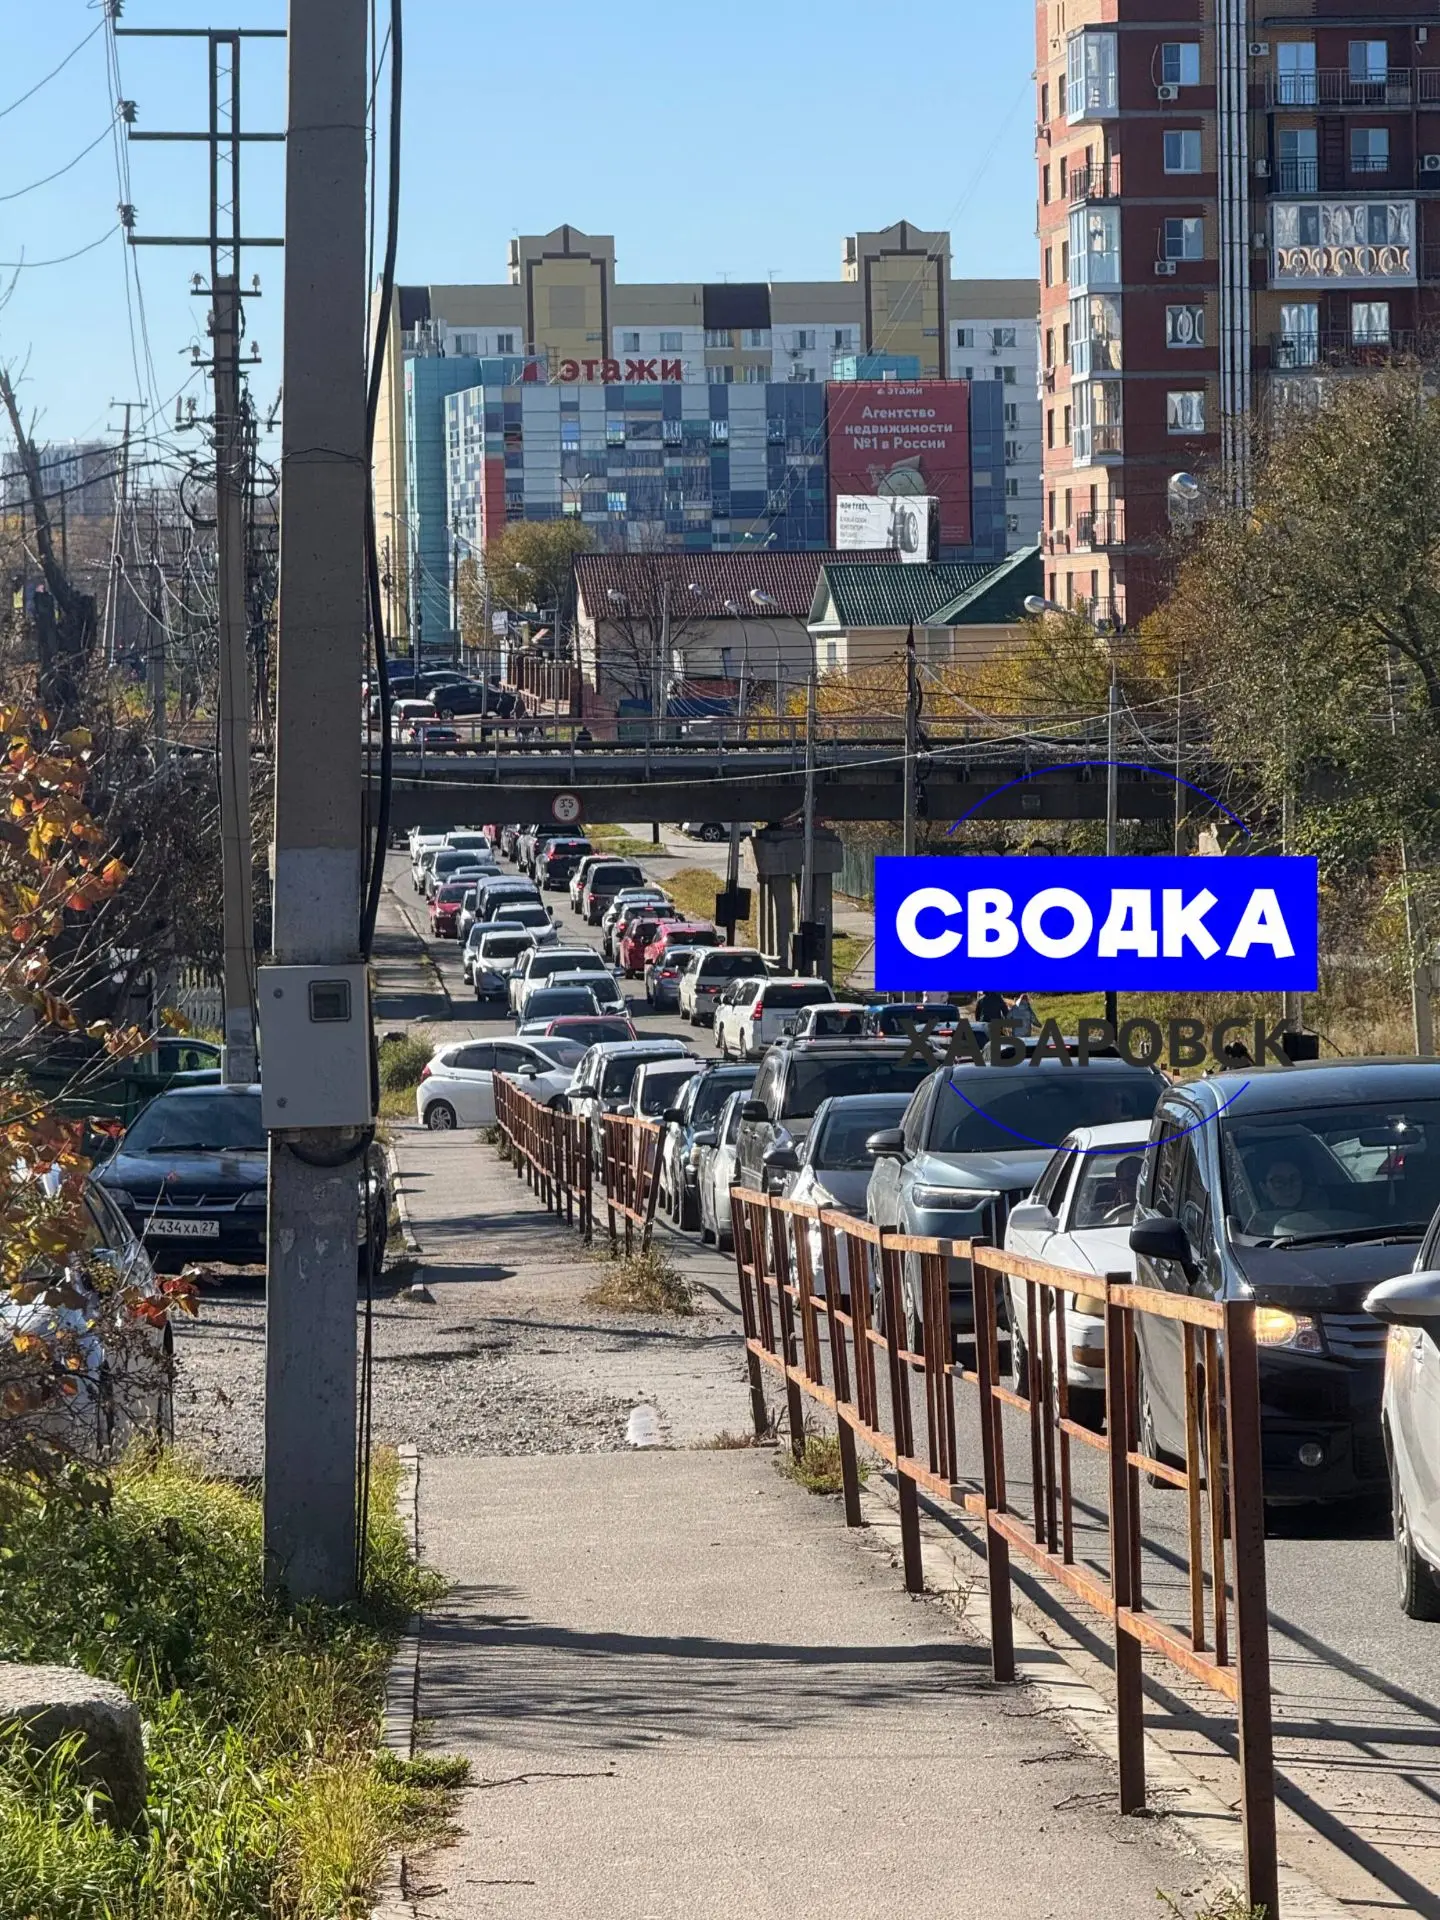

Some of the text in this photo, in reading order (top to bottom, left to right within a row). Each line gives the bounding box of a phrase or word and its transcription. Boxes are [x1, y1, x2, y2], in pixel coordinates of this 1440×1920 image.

[862, 406, 936, 418] Агентство
[845, 424, 953, 435] недвижимости
[853, 437, 946, 449] №1 в России
